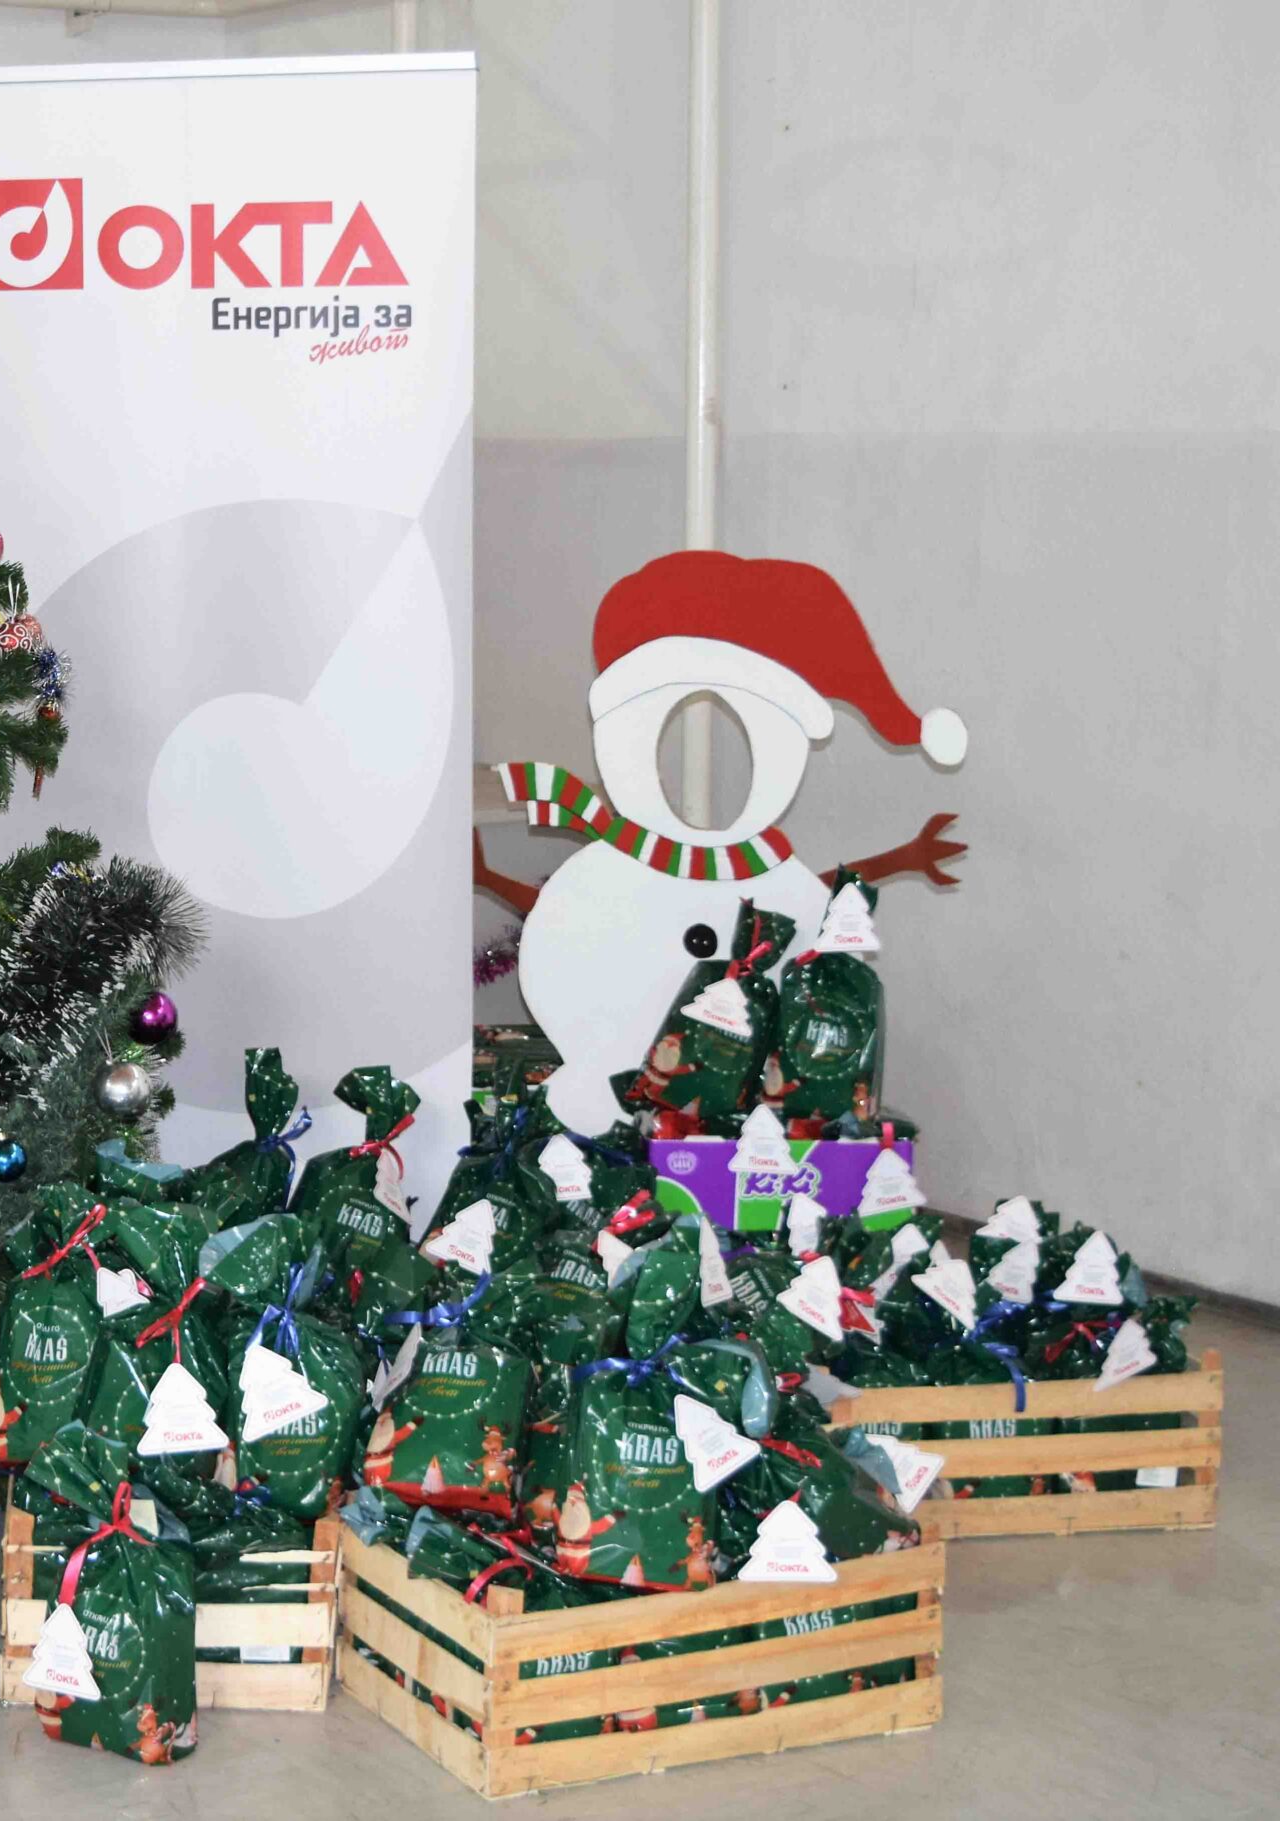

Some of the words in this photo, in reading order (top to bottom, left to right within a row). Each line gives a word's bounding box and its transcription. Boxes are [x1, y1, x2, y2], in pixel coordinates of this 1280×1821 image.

[97, 200, 410, 290] OKTA
[211, 295, 360, 338] Енергија
[374, 304, 413, 329] за
[308, 325, 410, 366] живот
